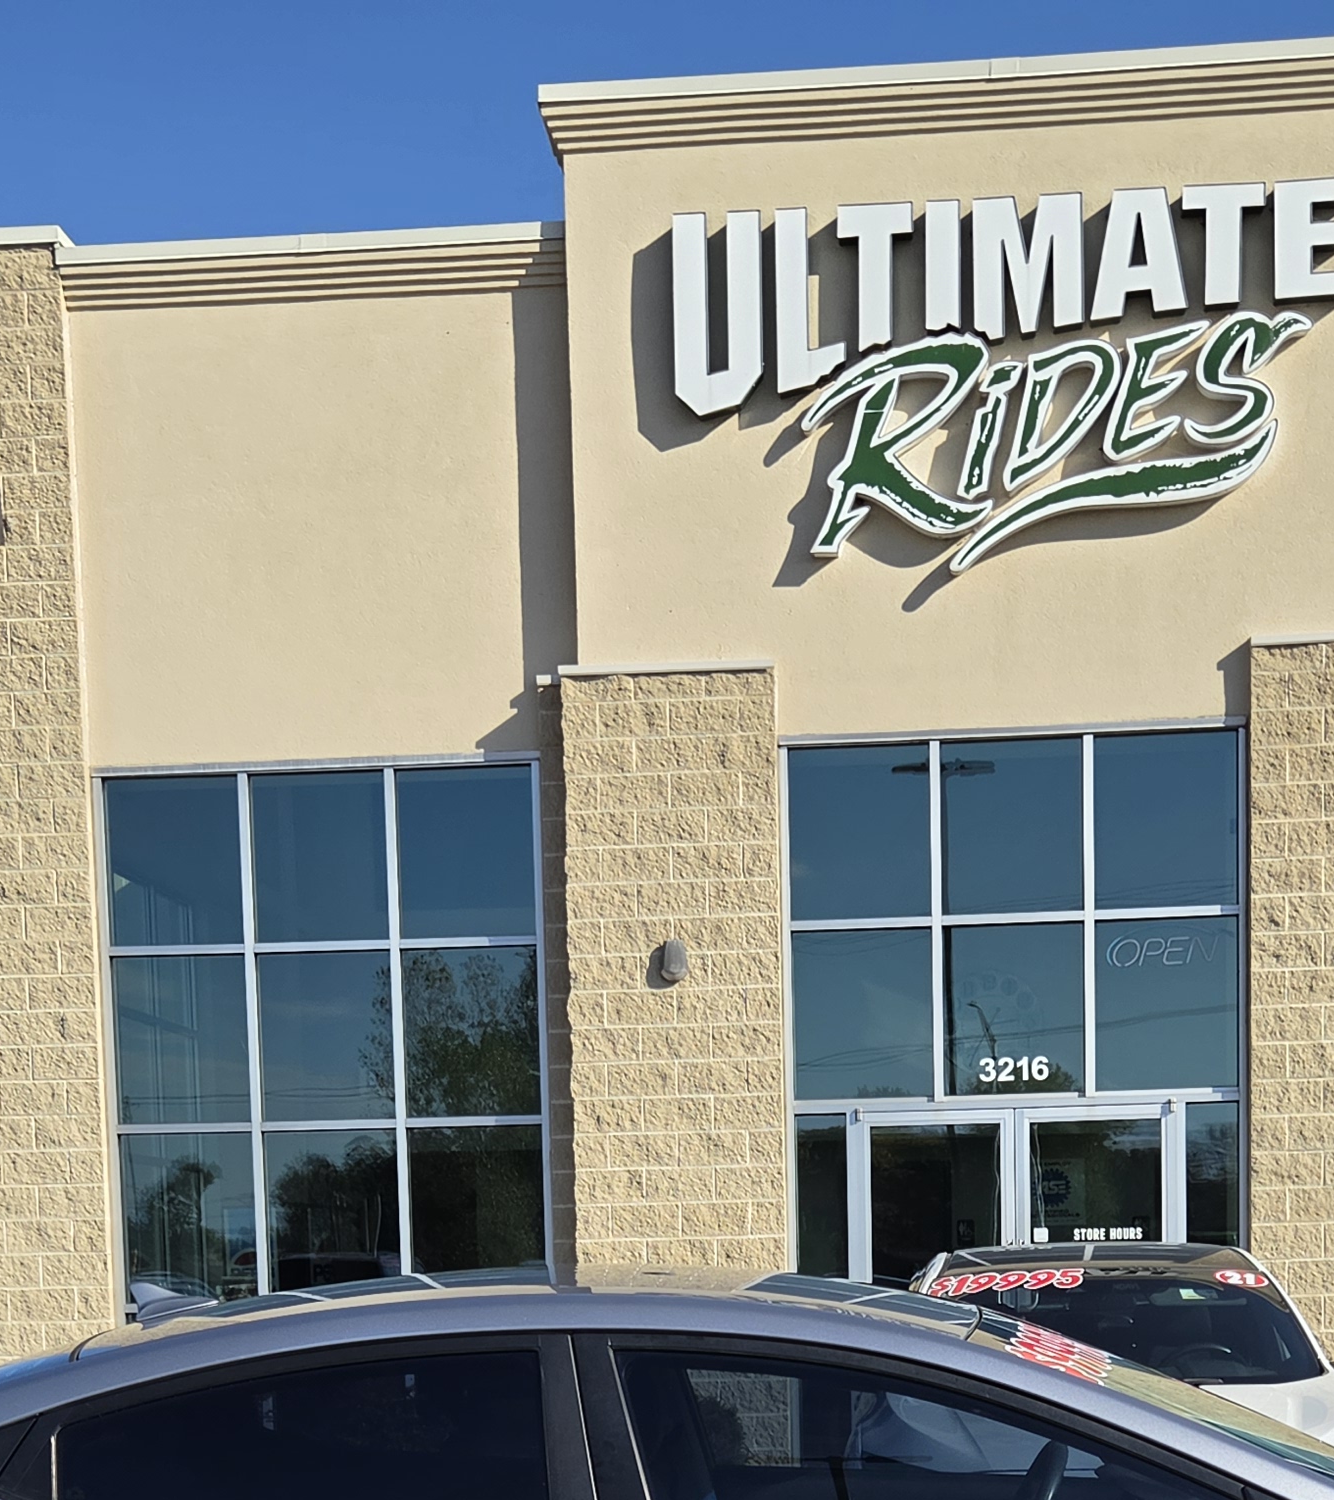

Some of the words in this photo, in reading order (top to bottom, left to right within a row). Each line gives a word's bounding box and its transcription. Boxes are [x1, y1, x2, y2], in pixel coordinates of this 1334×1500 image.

[1111, 936, 1218, 967] OPEN
[978, 1055, 1050, 1083] 3216
[1073, 1228, 1106, 1241] STORE
[1109, 1227, 1143, 1240] HOURS
[928, 1268, 1085, 1297] $19995
[1225, 1271, 1256, 1286] 21
